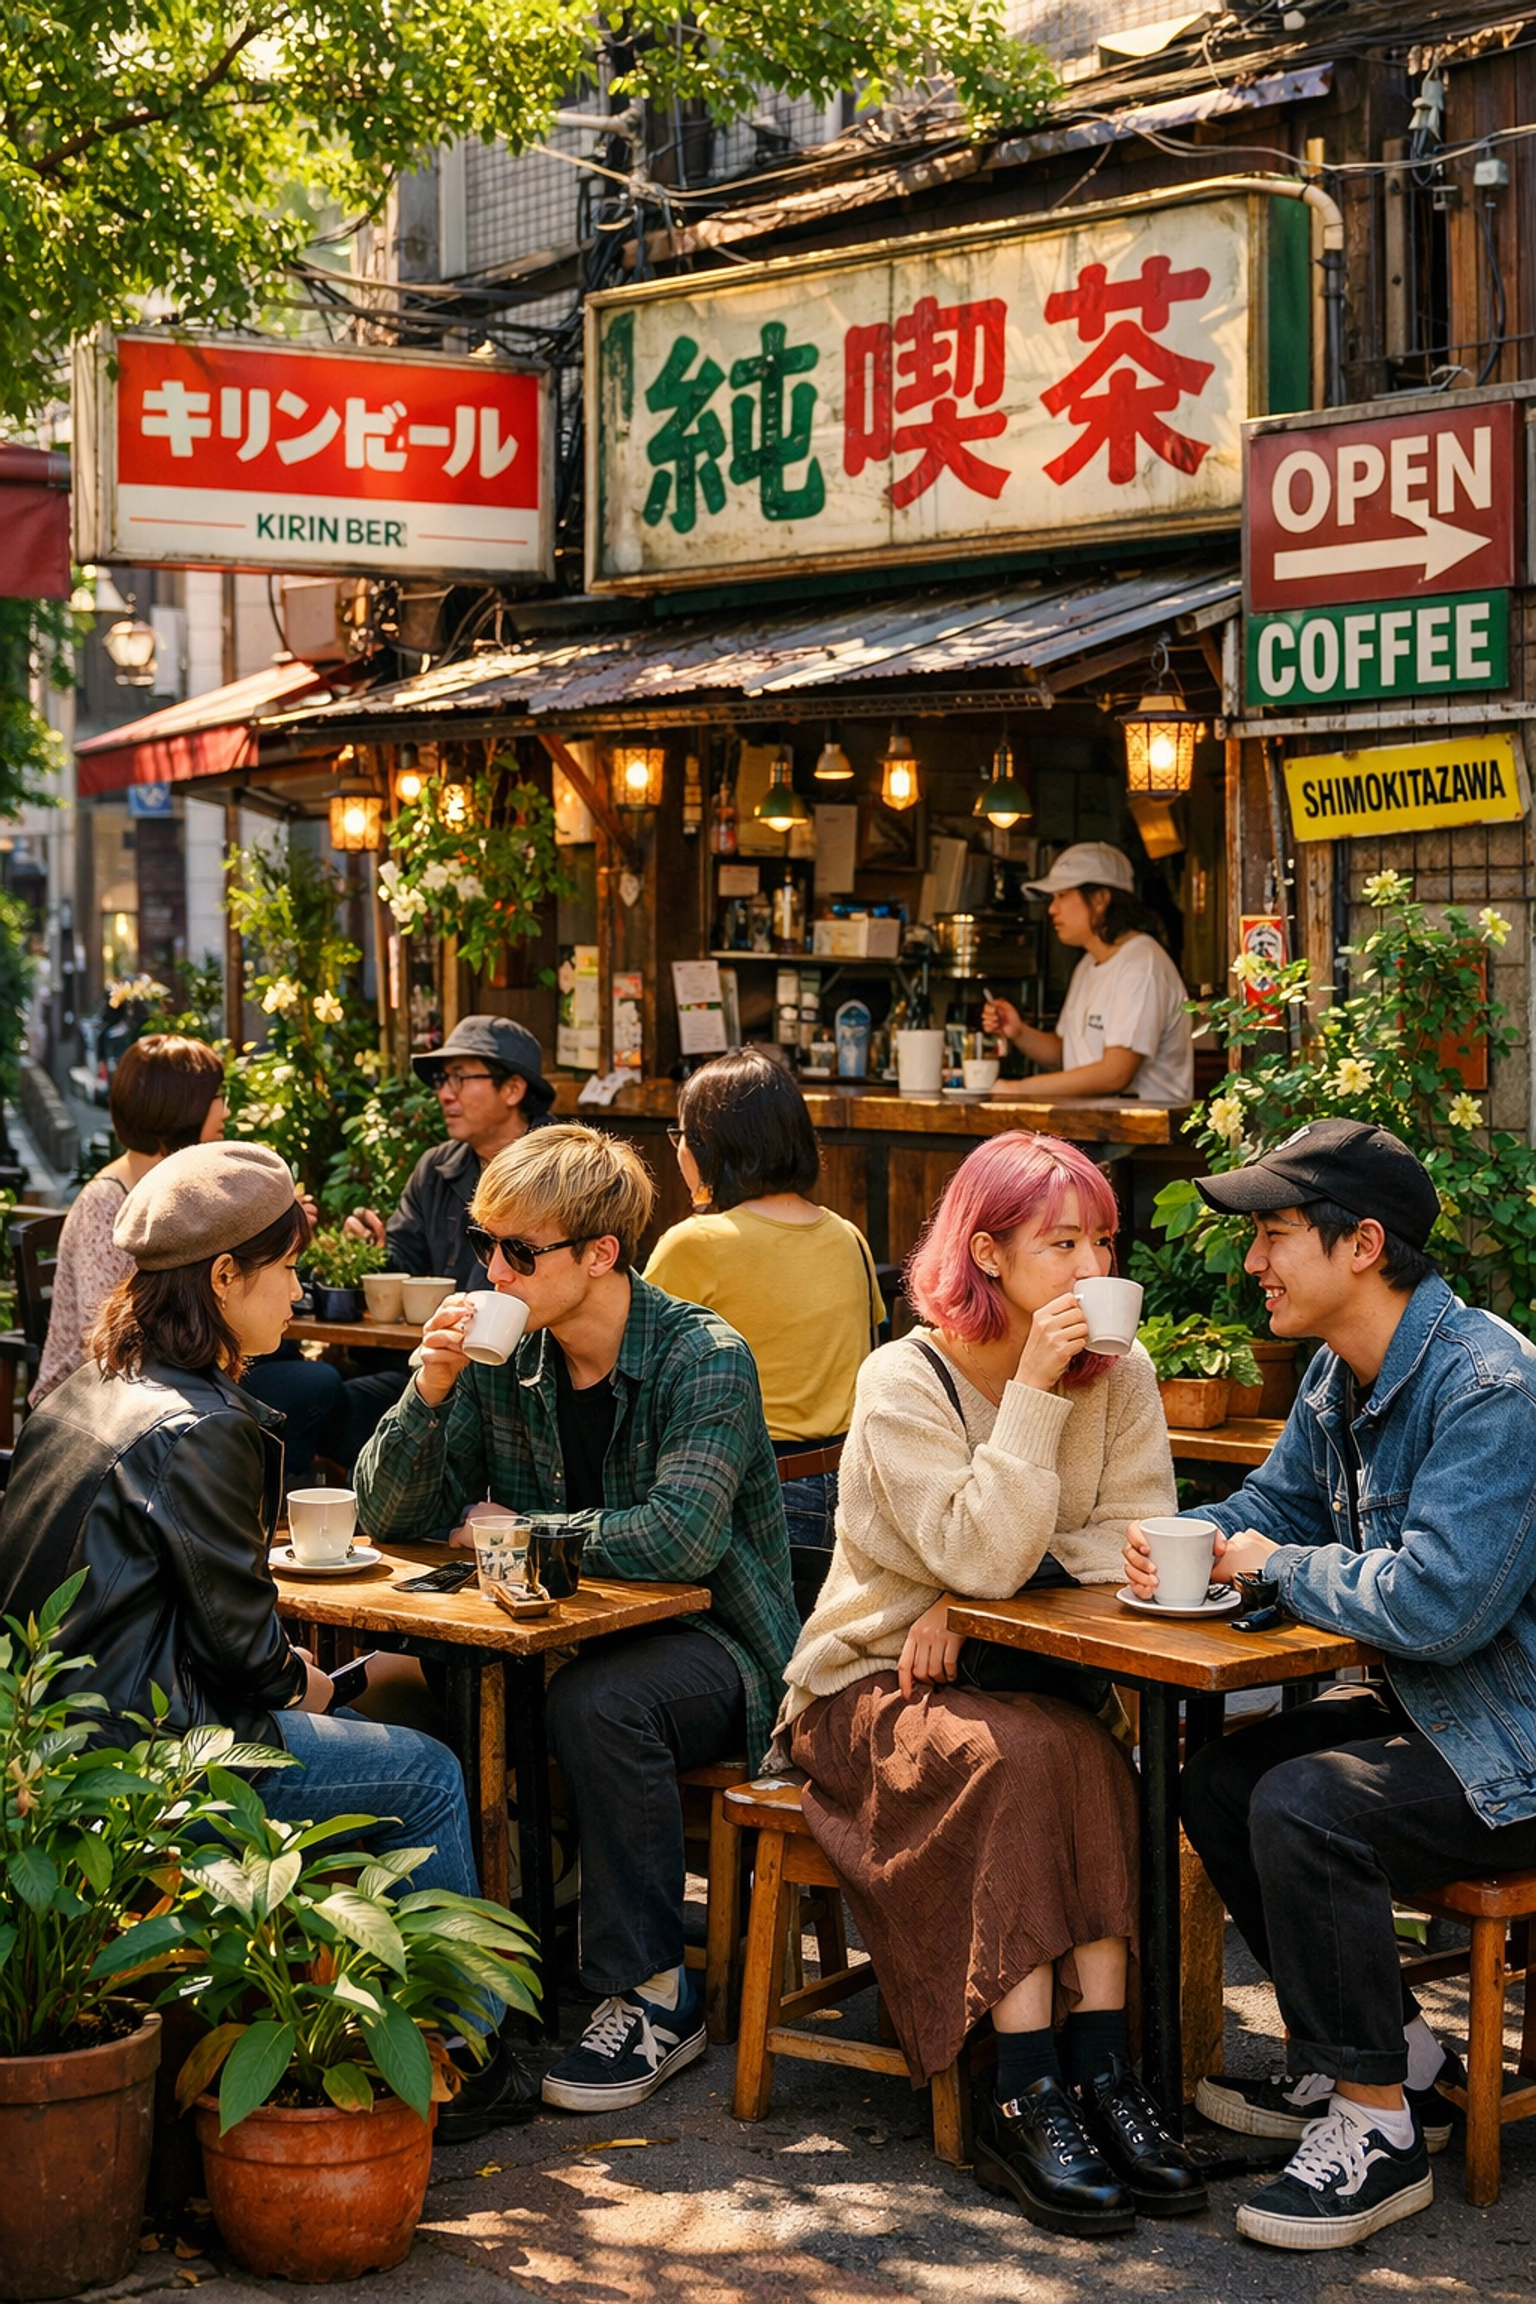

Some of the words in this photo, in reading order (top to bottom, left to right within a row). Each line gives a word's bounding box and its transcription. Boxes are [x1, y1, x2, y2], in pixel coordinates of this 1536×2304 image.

[141, 380, 518, 479] キリンビール
[643, 255, 1215, 533] 純喫茶
[257, 512, 338, 543] KIRIN
[1271, 426, 1492, 533] OPEN
[1257, 602, 1491, 697] COFFEE
[1302, 759, 1506, 818] SHIMOKITAZAWA
